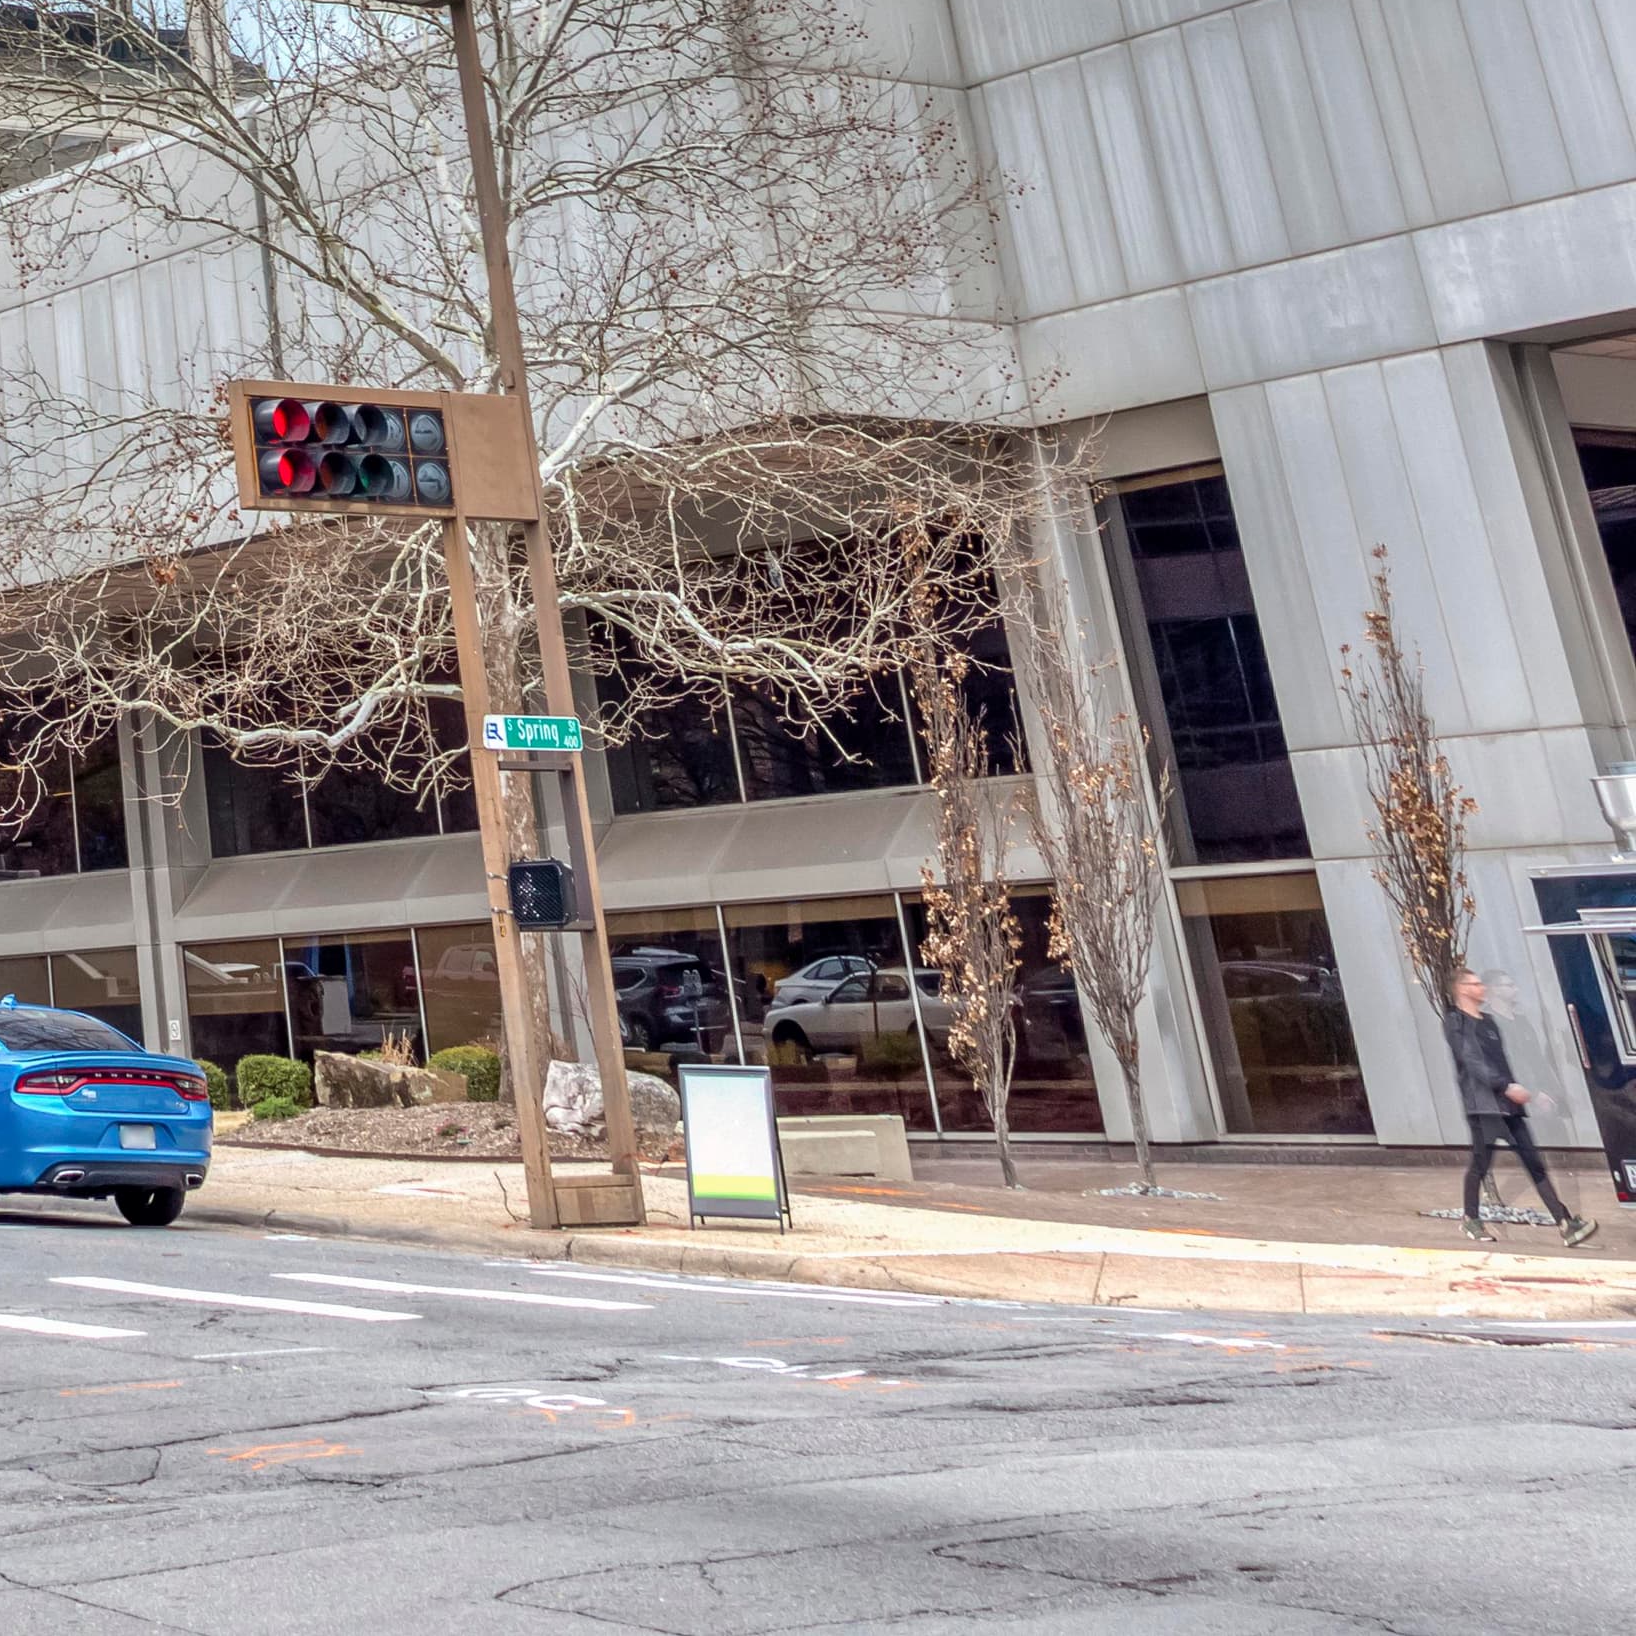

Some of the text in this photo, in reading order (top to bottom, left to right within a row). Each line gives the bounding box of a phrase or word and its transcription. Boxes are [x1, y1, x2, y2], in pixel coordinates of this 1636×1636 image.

[507, 719, 513, 732] S
[517, 718, 560, 748] Spring
[563, 736, 580, 749] 400
